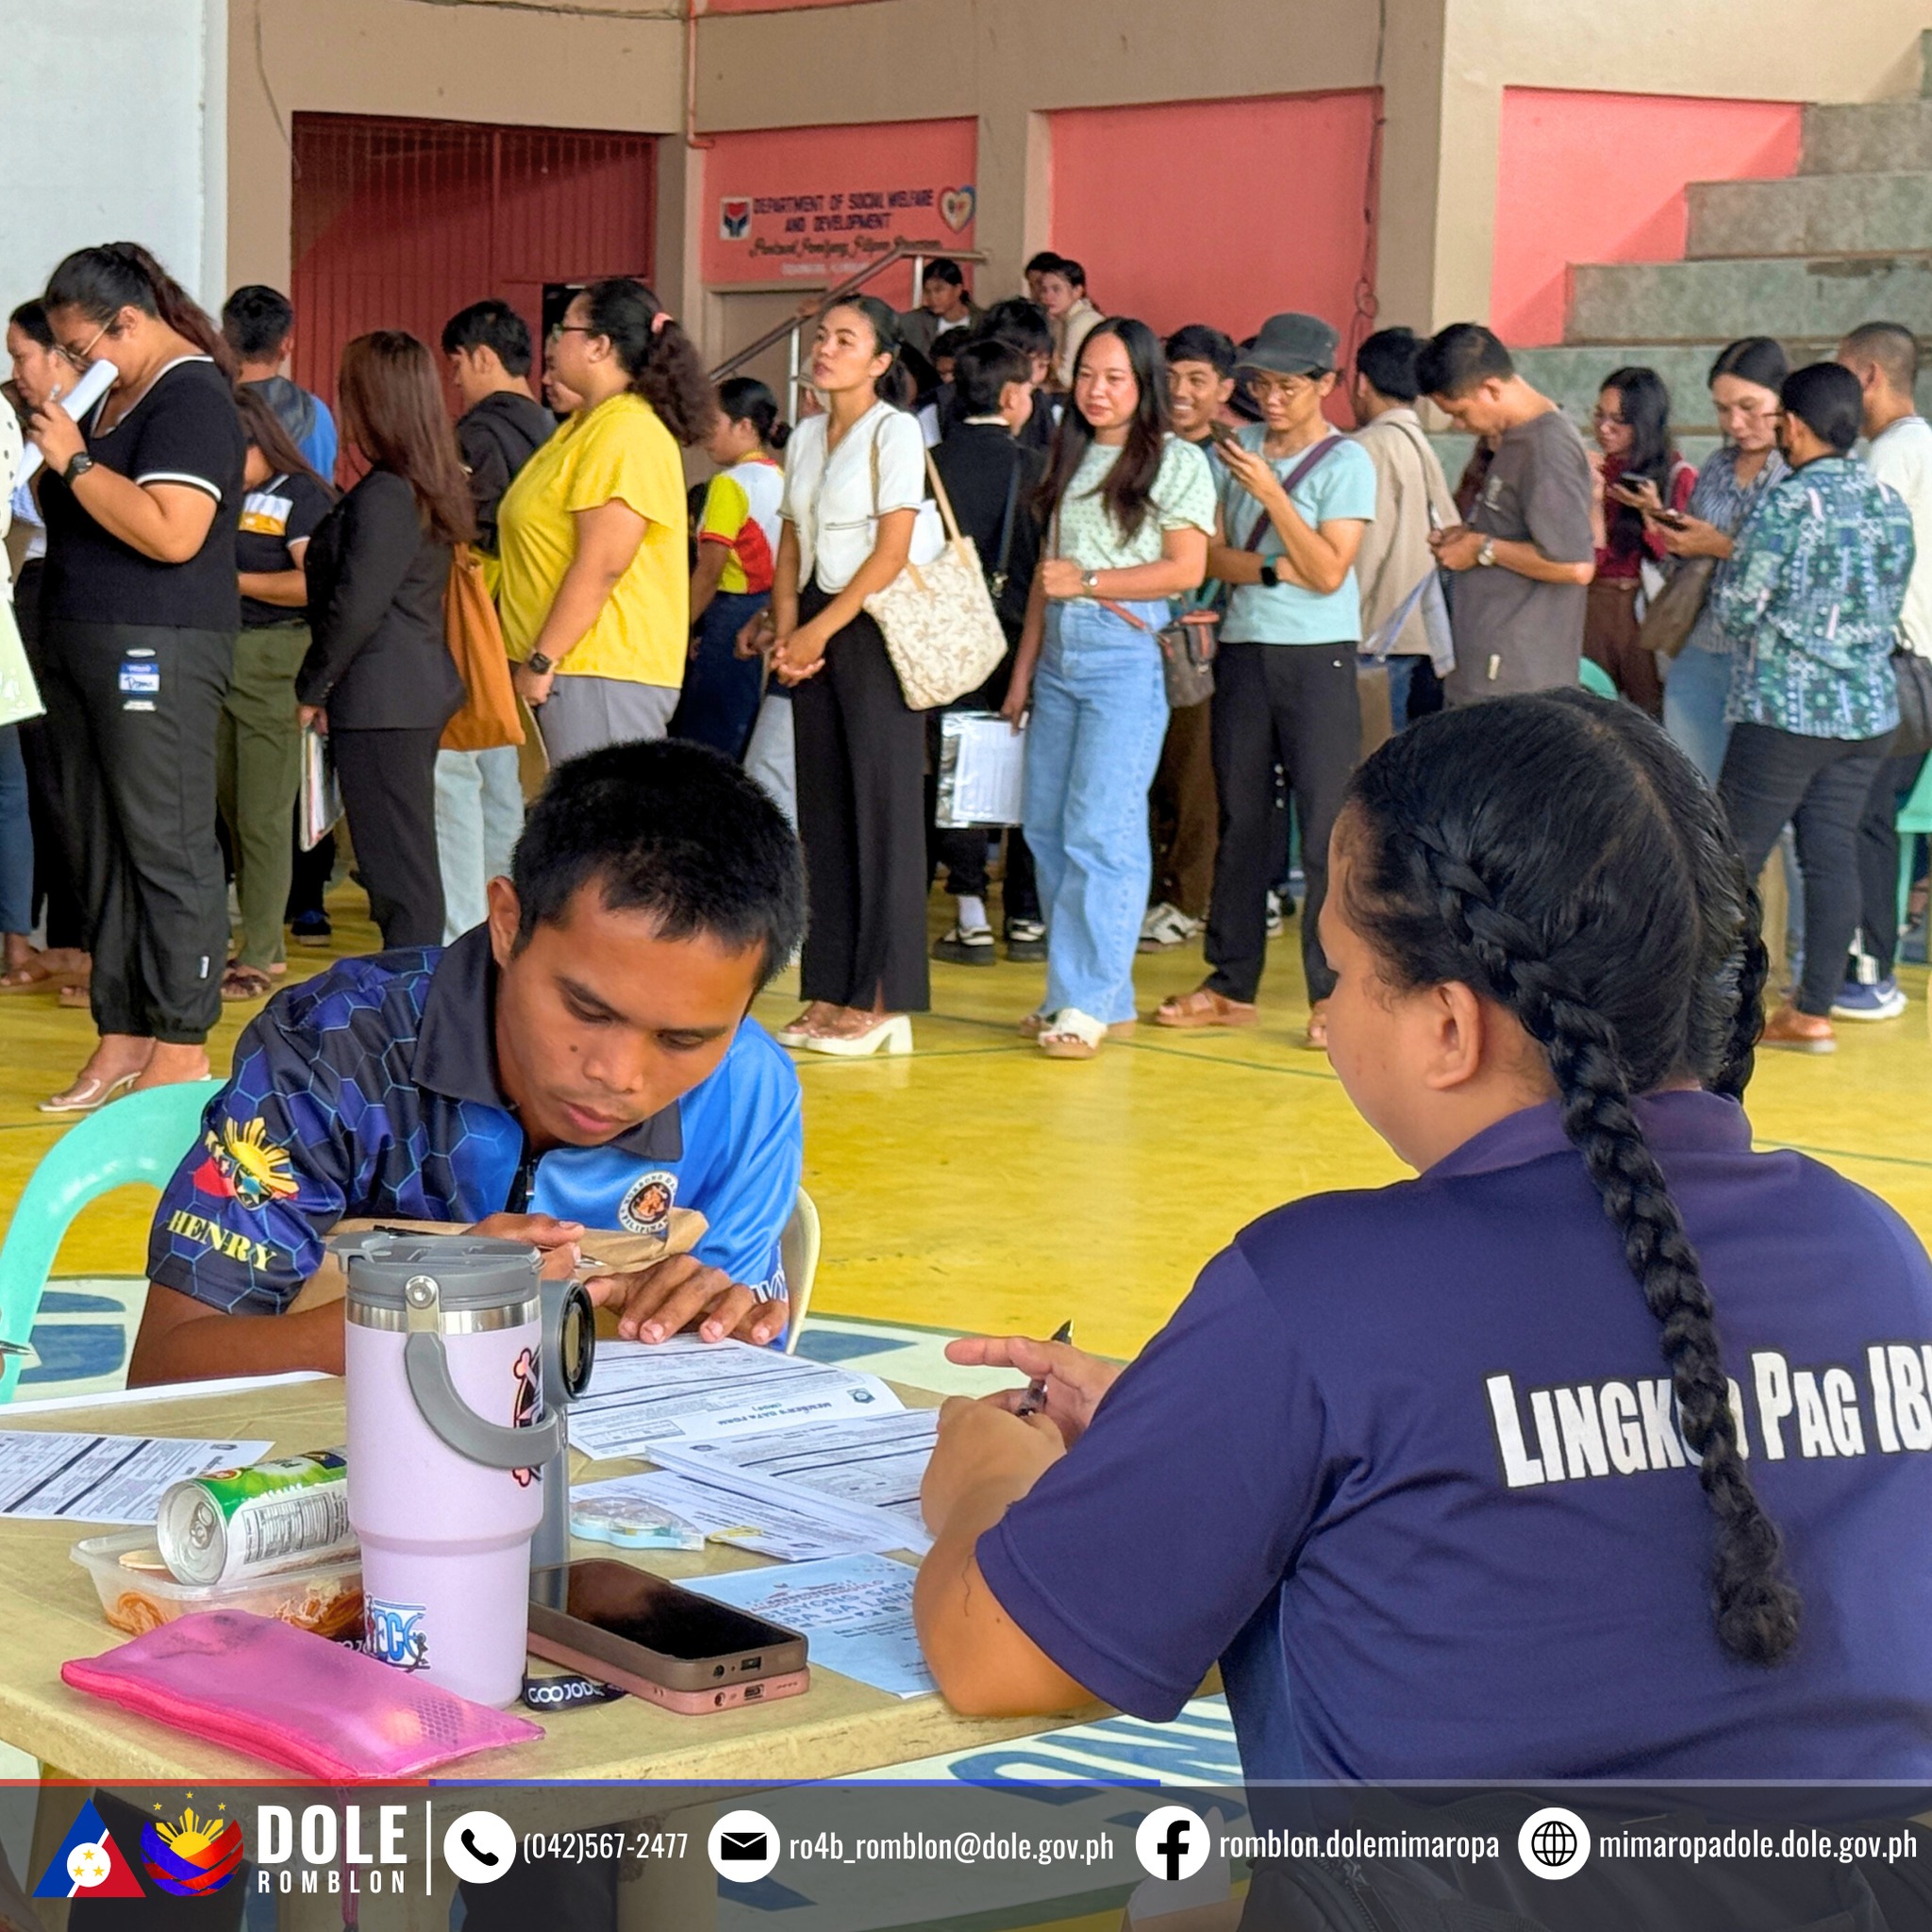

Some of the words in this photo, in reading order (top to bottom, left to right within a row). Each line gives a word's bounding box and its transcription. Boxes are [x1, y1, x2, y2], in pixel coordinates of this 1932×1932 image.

[752, 194, 824, 214] DEPARTMENT
[830, 192, 843, 209] OF
[849, 191, 885, 209] SOCIAL
[785, 216, 806, 233] AND
[814, 212, 891, 232] DEVELOPMENT
[166, 1209, 277, 1272] HENRY
[1486, 1374, 1749, 1488] LINGKD
[1751, 1352, 1866, 1460] PAG
